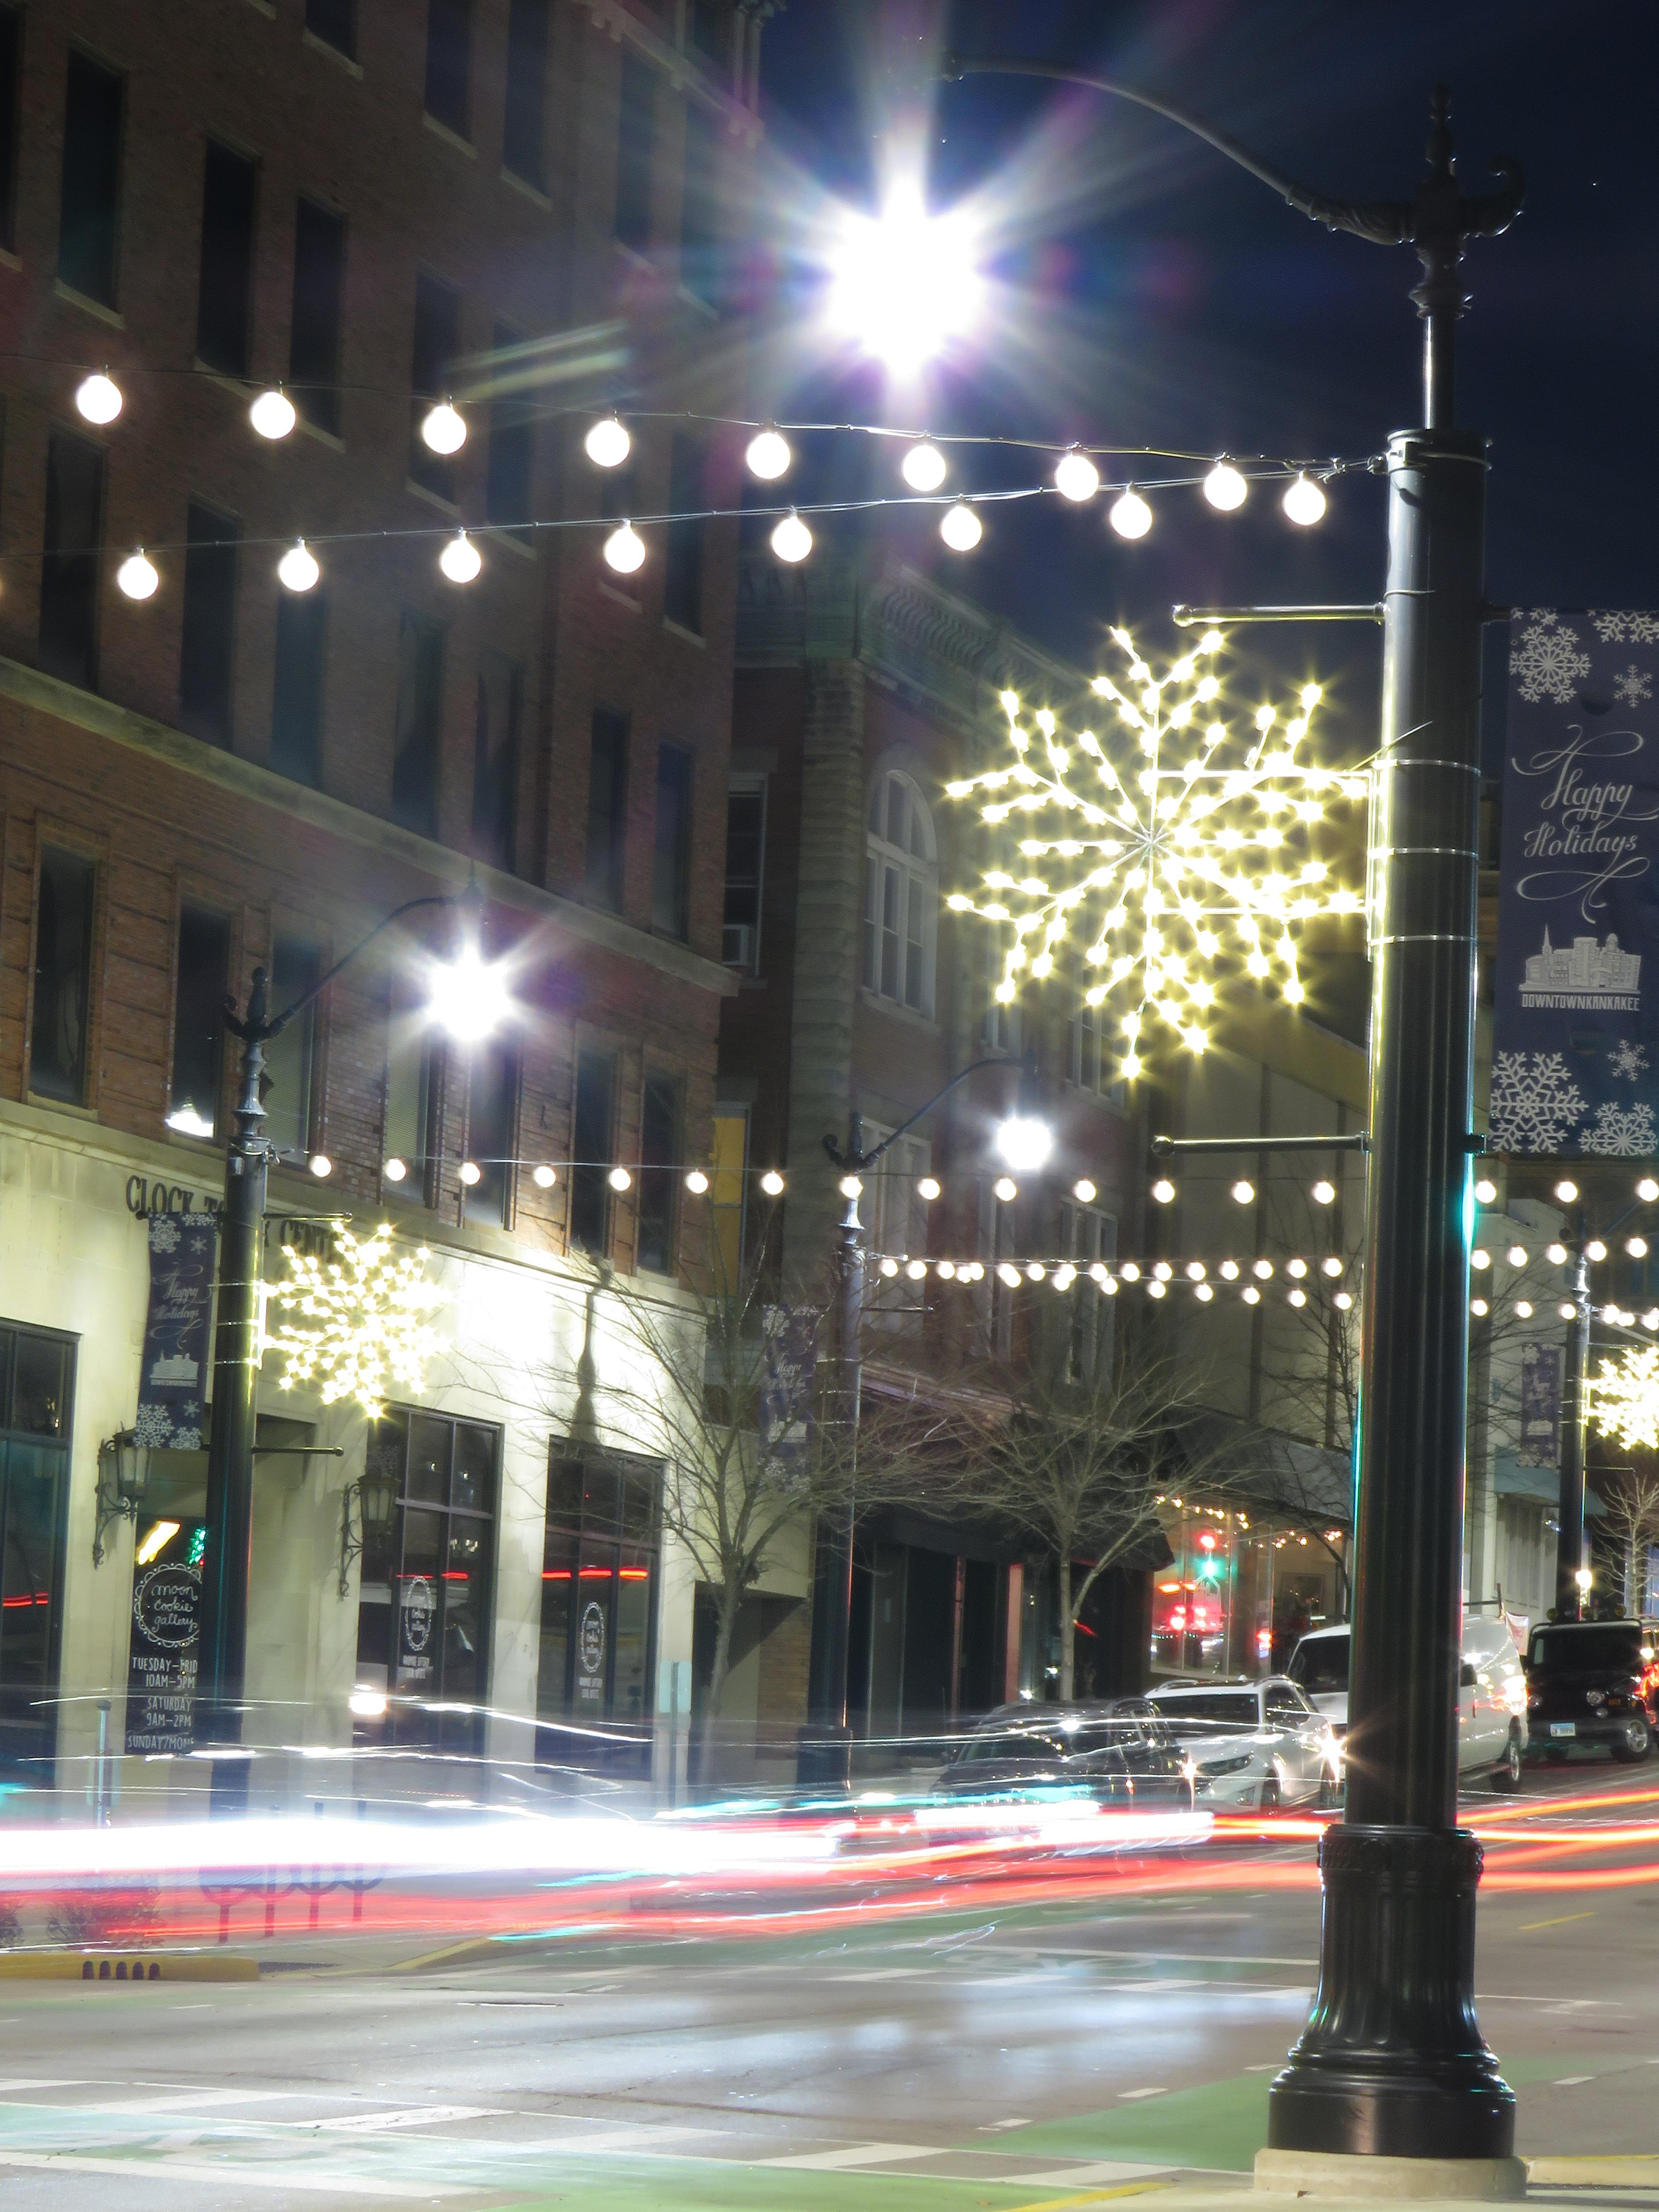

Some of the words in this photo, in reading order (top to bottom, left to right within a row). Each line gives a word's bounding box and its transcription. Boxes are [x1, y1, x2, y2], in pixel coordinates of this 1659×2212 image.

[126, 1175, 194, 1214] CLOCK
[151, 1585, 198, 1601] moon
[151, 1613, 198, 1633] gallery
[148, 1696, 192, 1712] SATURDAY
